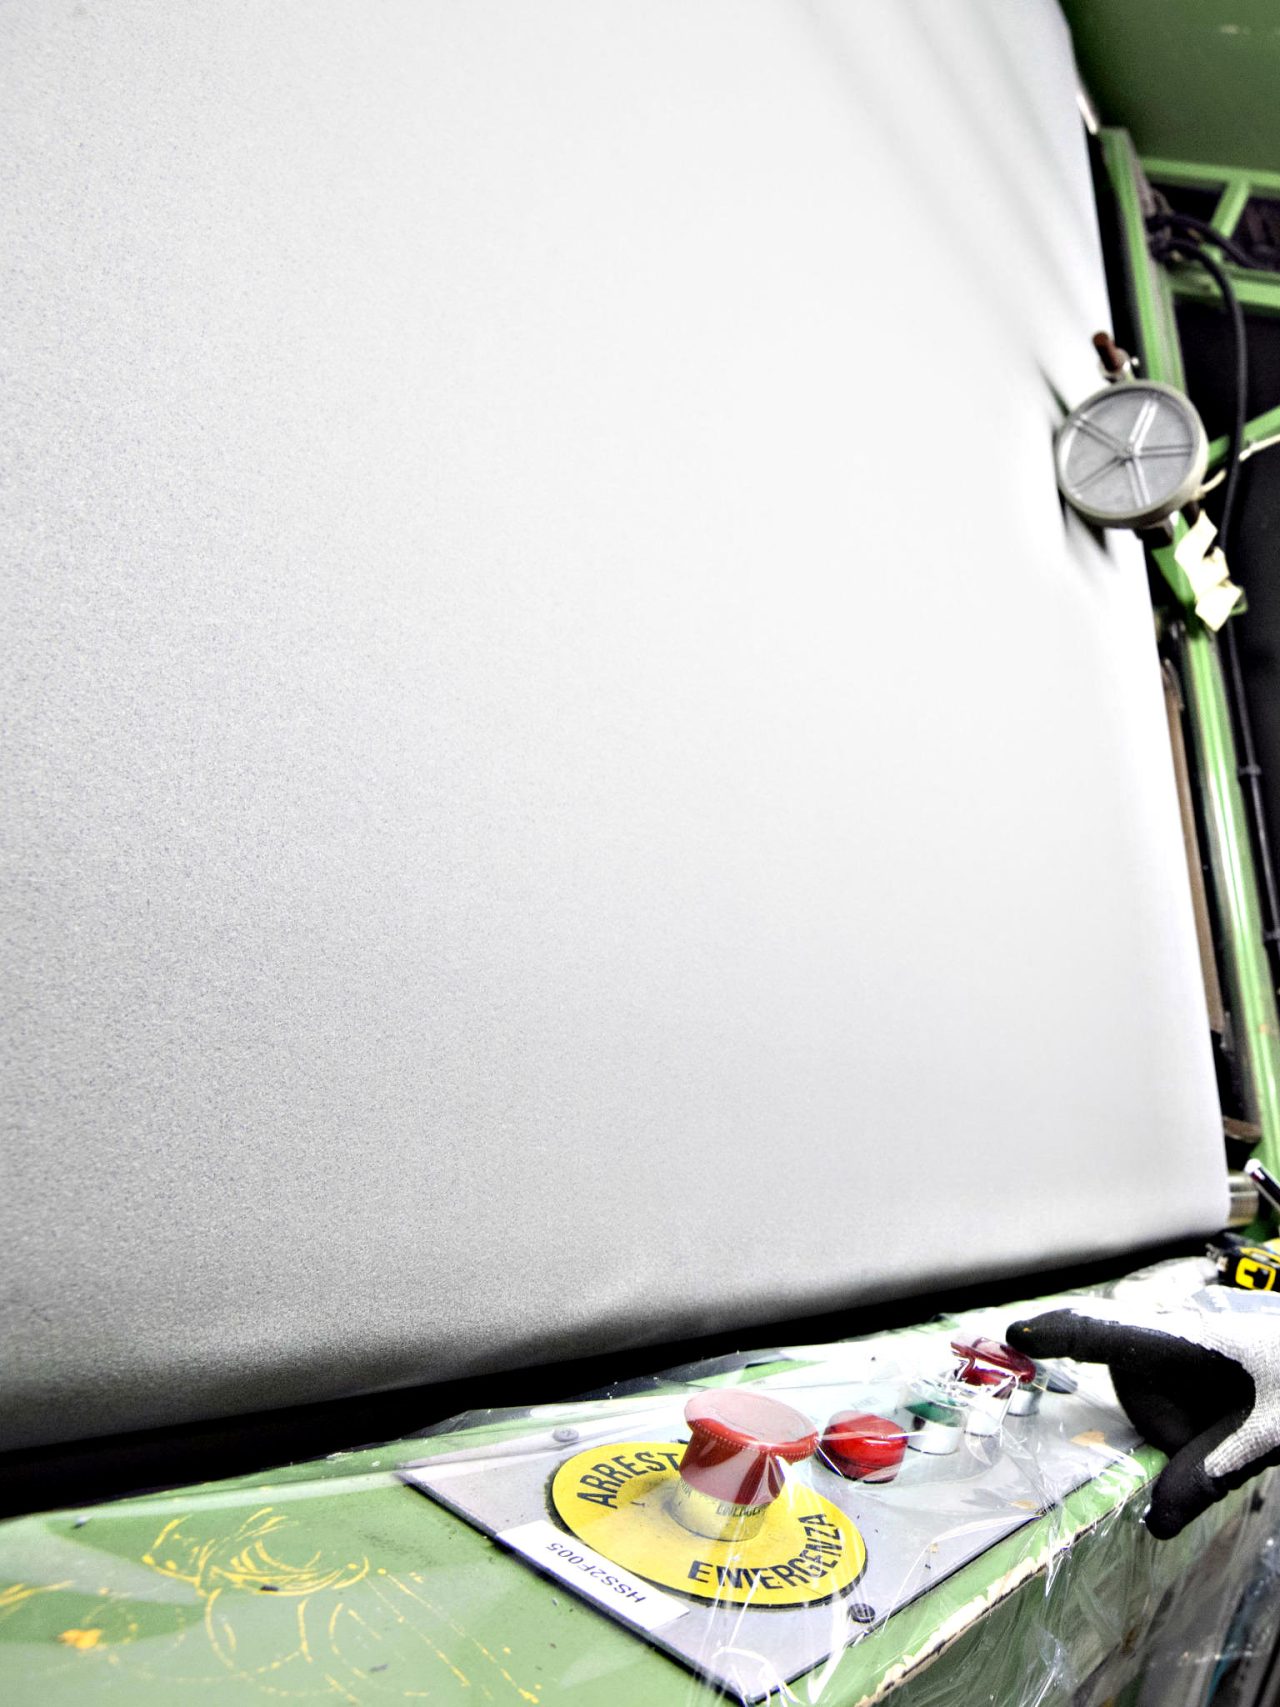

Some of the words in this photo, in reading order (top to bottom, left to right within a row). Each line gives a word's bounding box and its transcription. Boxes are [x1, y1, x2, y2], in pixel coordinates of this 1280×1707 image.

[576, 1451, 682, 1510] ARREST
[545, 1541, 647, 1603] HSS2F005
[687, 1513, 843, 1590] EMERGENZA
